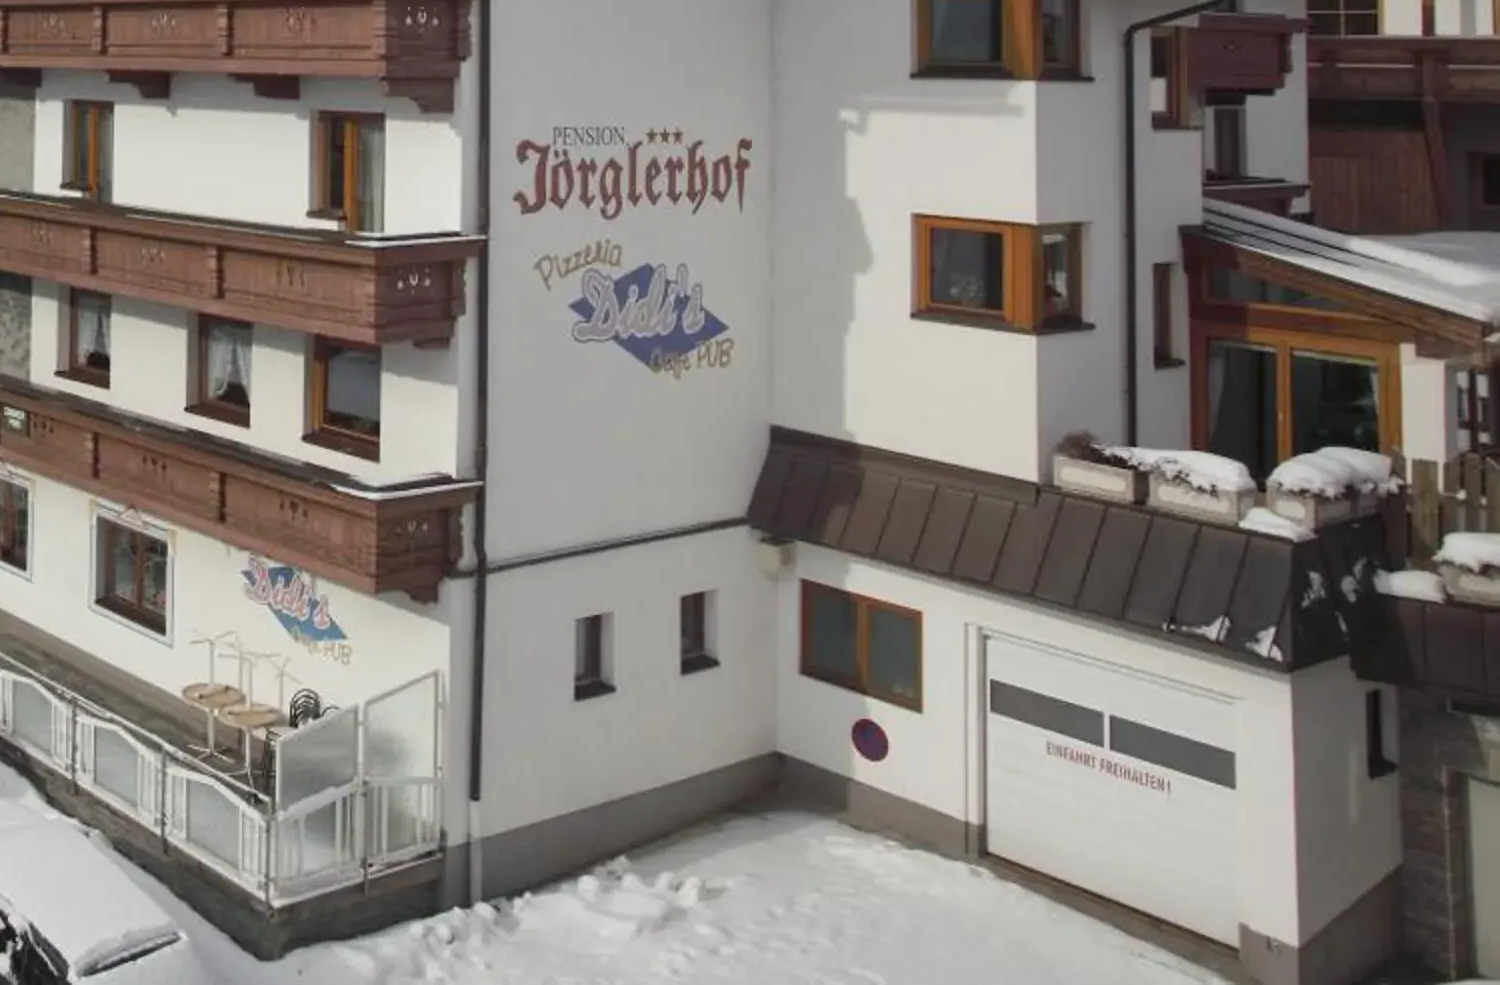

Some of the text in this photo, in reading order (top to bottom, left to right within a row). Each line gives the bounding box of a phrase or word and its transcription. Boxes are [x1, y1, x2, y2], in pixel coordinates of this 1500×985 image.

[552, 126, 626, 146] PENSION
[512, 137, 753, 220] Jörglerhof
[534, 239, 623, 292] Pizzeria
[572, 263, 705, 344] Didi's
[1046, 740, 1097, 769] EINFAHRT
